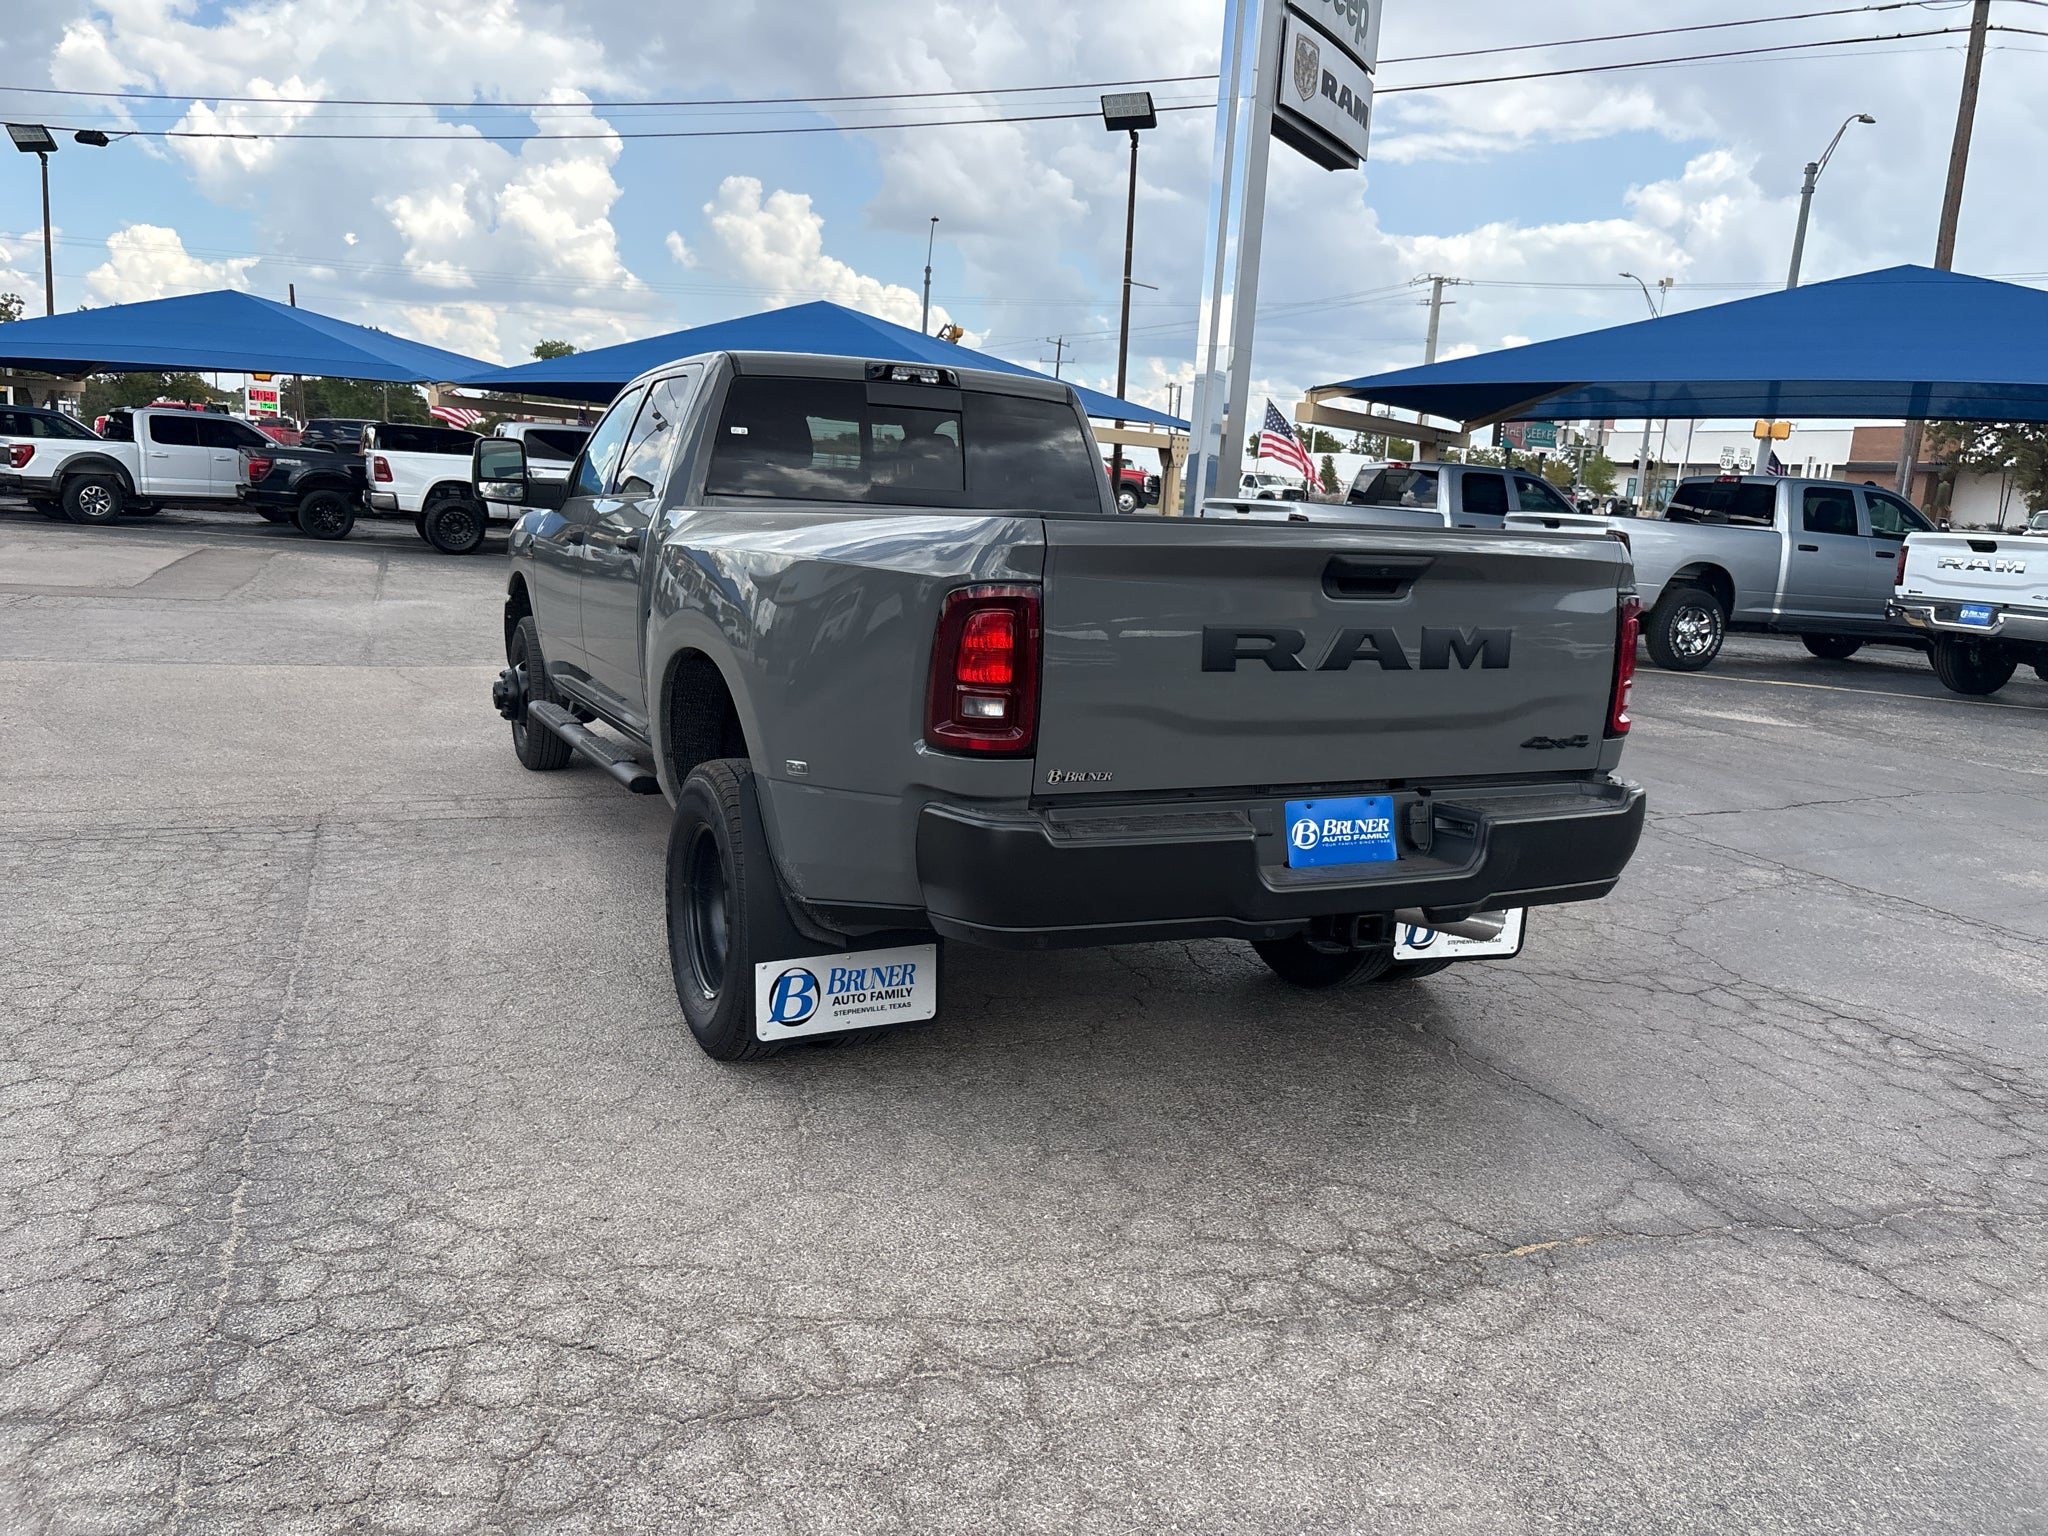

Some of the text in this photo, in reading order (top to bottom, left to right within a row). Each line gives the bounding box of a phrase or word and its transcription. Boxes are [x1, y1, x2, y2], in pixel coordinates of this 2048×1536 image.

[1320, 69, 1369, 131] RAM
[1505, 425, 1522, 437] THE
[1937, 556, 2027, 574] RAM
[1201, 624, 1513, 672] RAM
[1064, 771, 1113, 782] BRUNER
[1293, 818, 1390, 847] B BRUNER
[1322, 832, 1390, 843] AUTO FAMILY
[767, 963, 917, 1023] B BRUNER
[832, 987, 913, 1007] AUTO FAMILY
[833, 1001, 912, 1017] STEPHENVILLE, TEXAS
